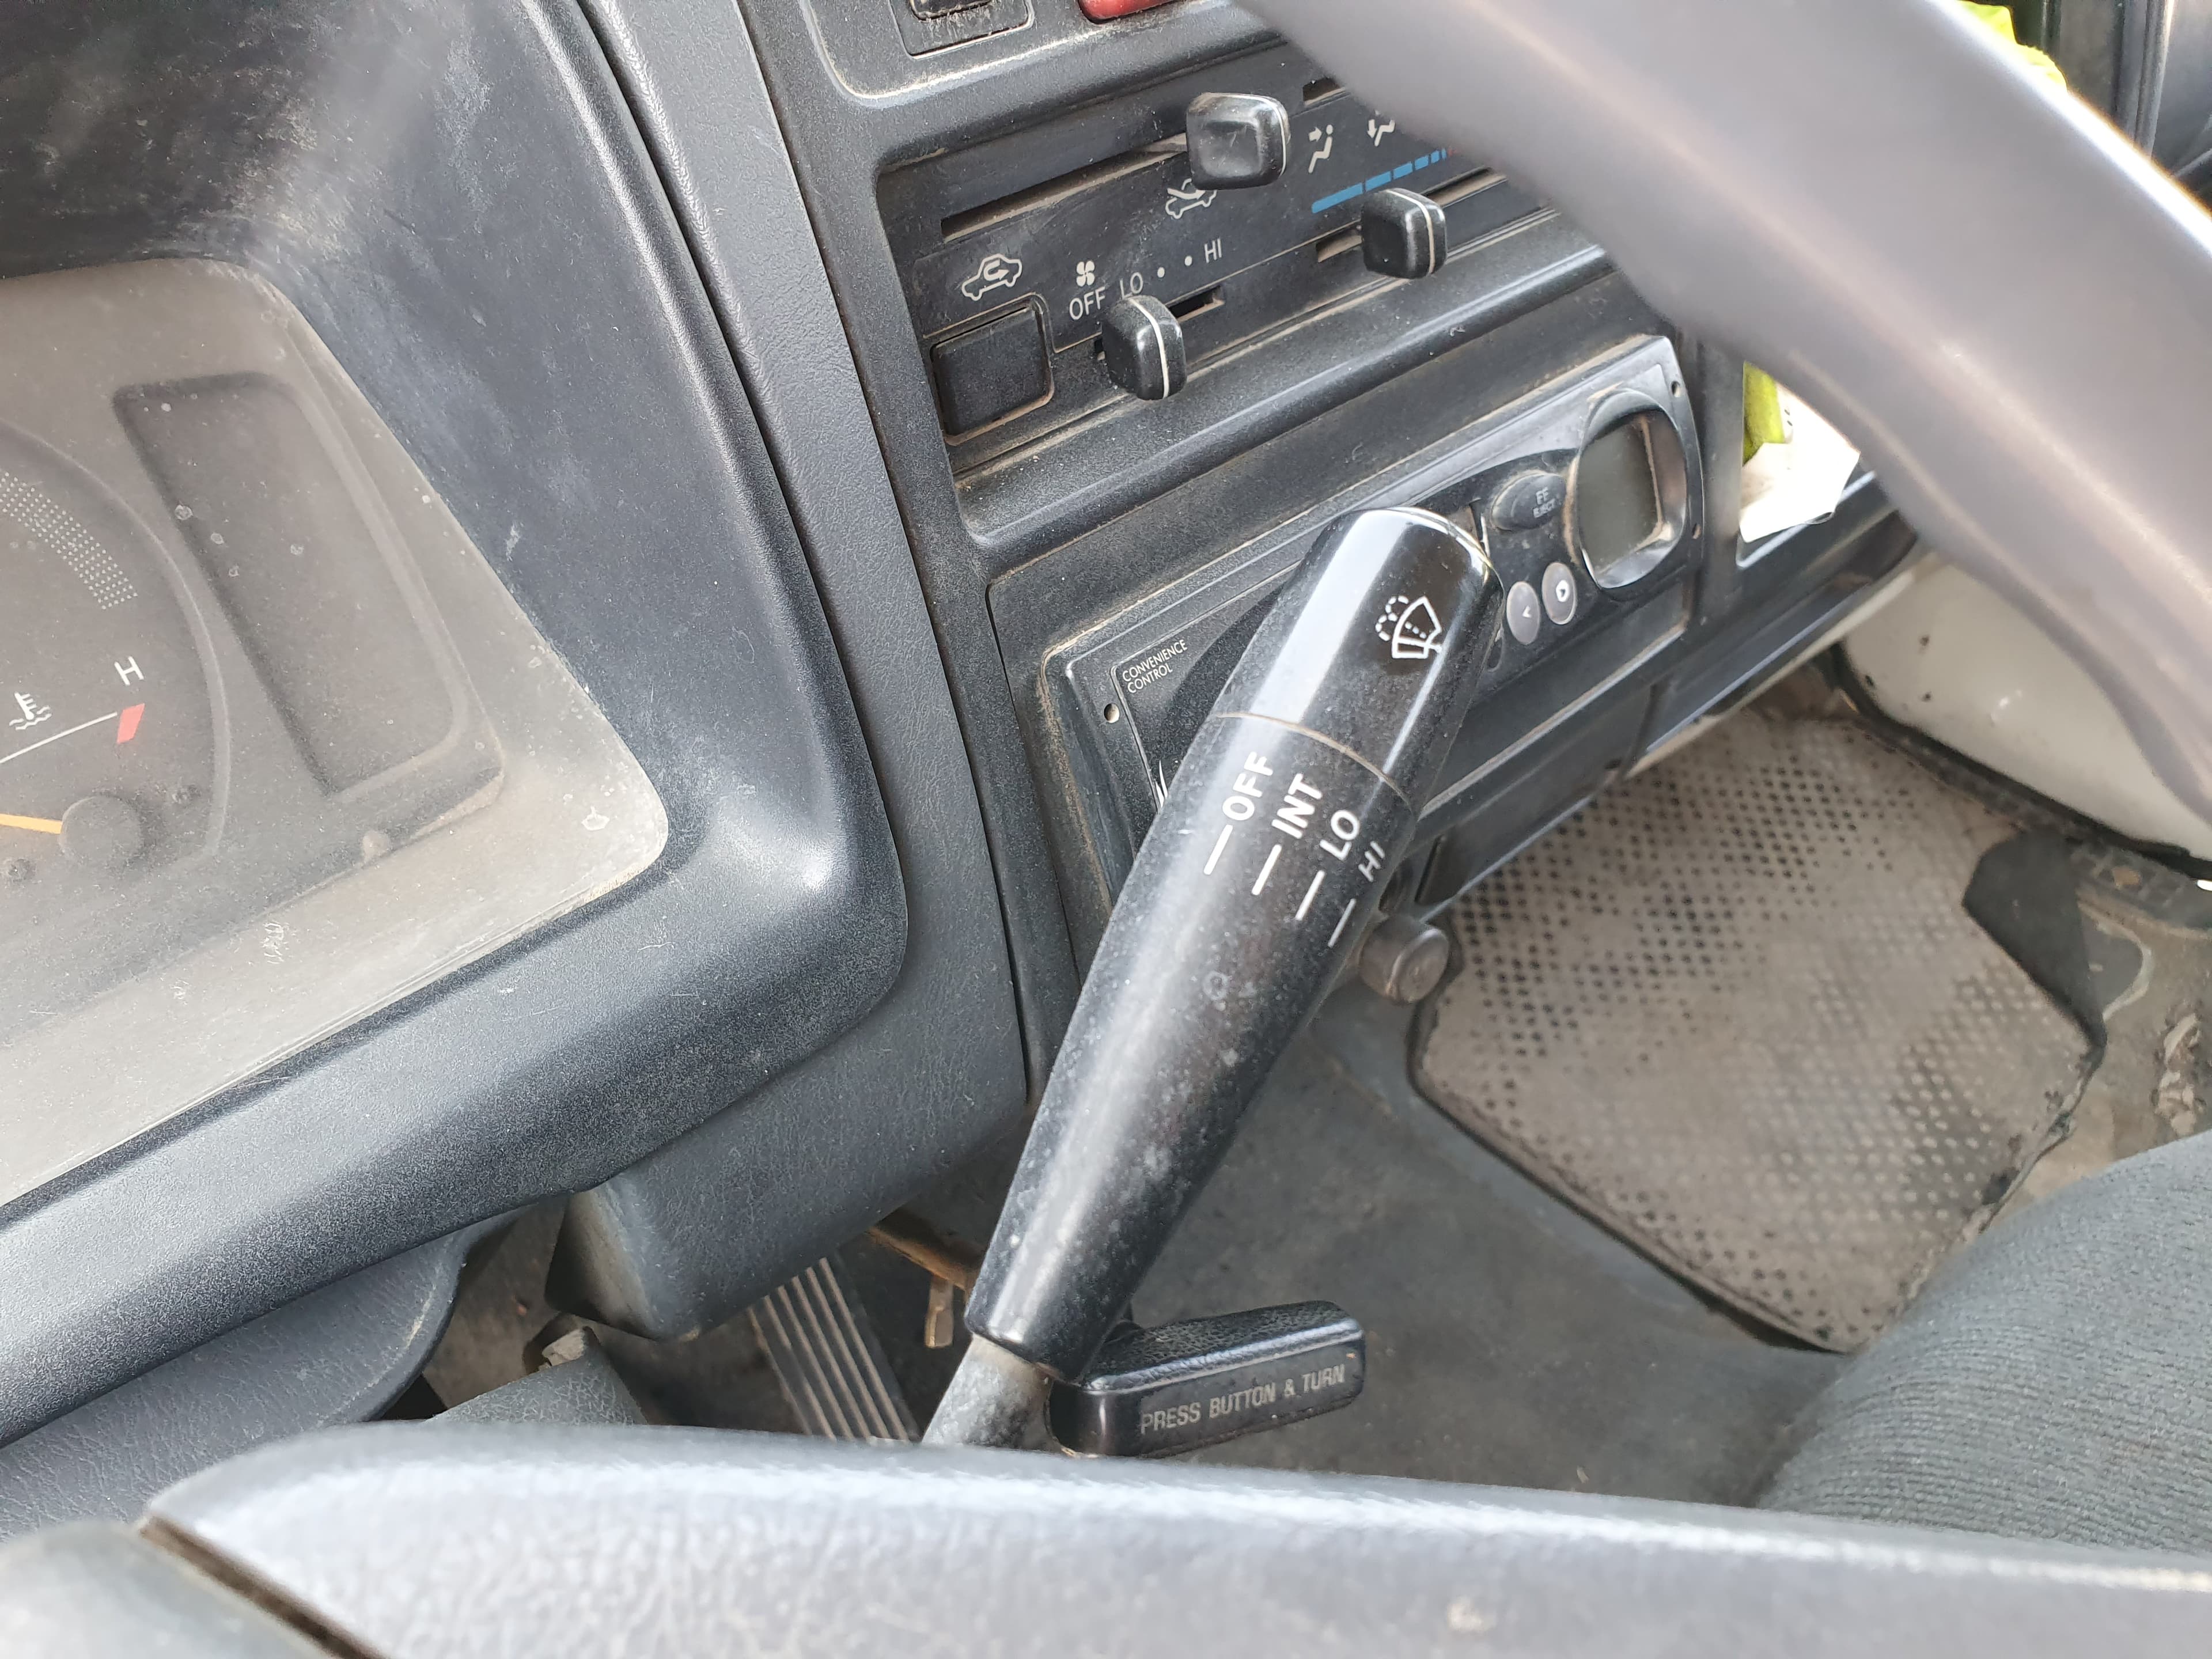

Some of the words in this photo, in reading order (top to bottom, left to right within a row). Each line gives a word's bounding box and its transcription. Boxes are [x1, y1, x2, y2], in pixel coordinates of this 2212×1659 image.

[1205, 238, 1222, 263] HI
[1069, 286, 1105, 320] OFF
[1120, 272, 1143, 300] LO
[114, 656, 144, 685] H
[1122, 639, 1188, 681] CONVENIENCE
[1127, 662, 1173, 693] CONTROL
[1222, 751, 1274, 821] OFF
[1271, 772, 1323, 839] INT
[1319, 809, 1361, 861] LO
[1358, 840, 1385, 882] HI
[1140, 1402, 1201, 1435] PRESS
[1209, 1382, 1276, 1418] BUTTON
[1284, 1378, 1296, 1397] &
[1301, 1363, 1345, 1392] TURN
